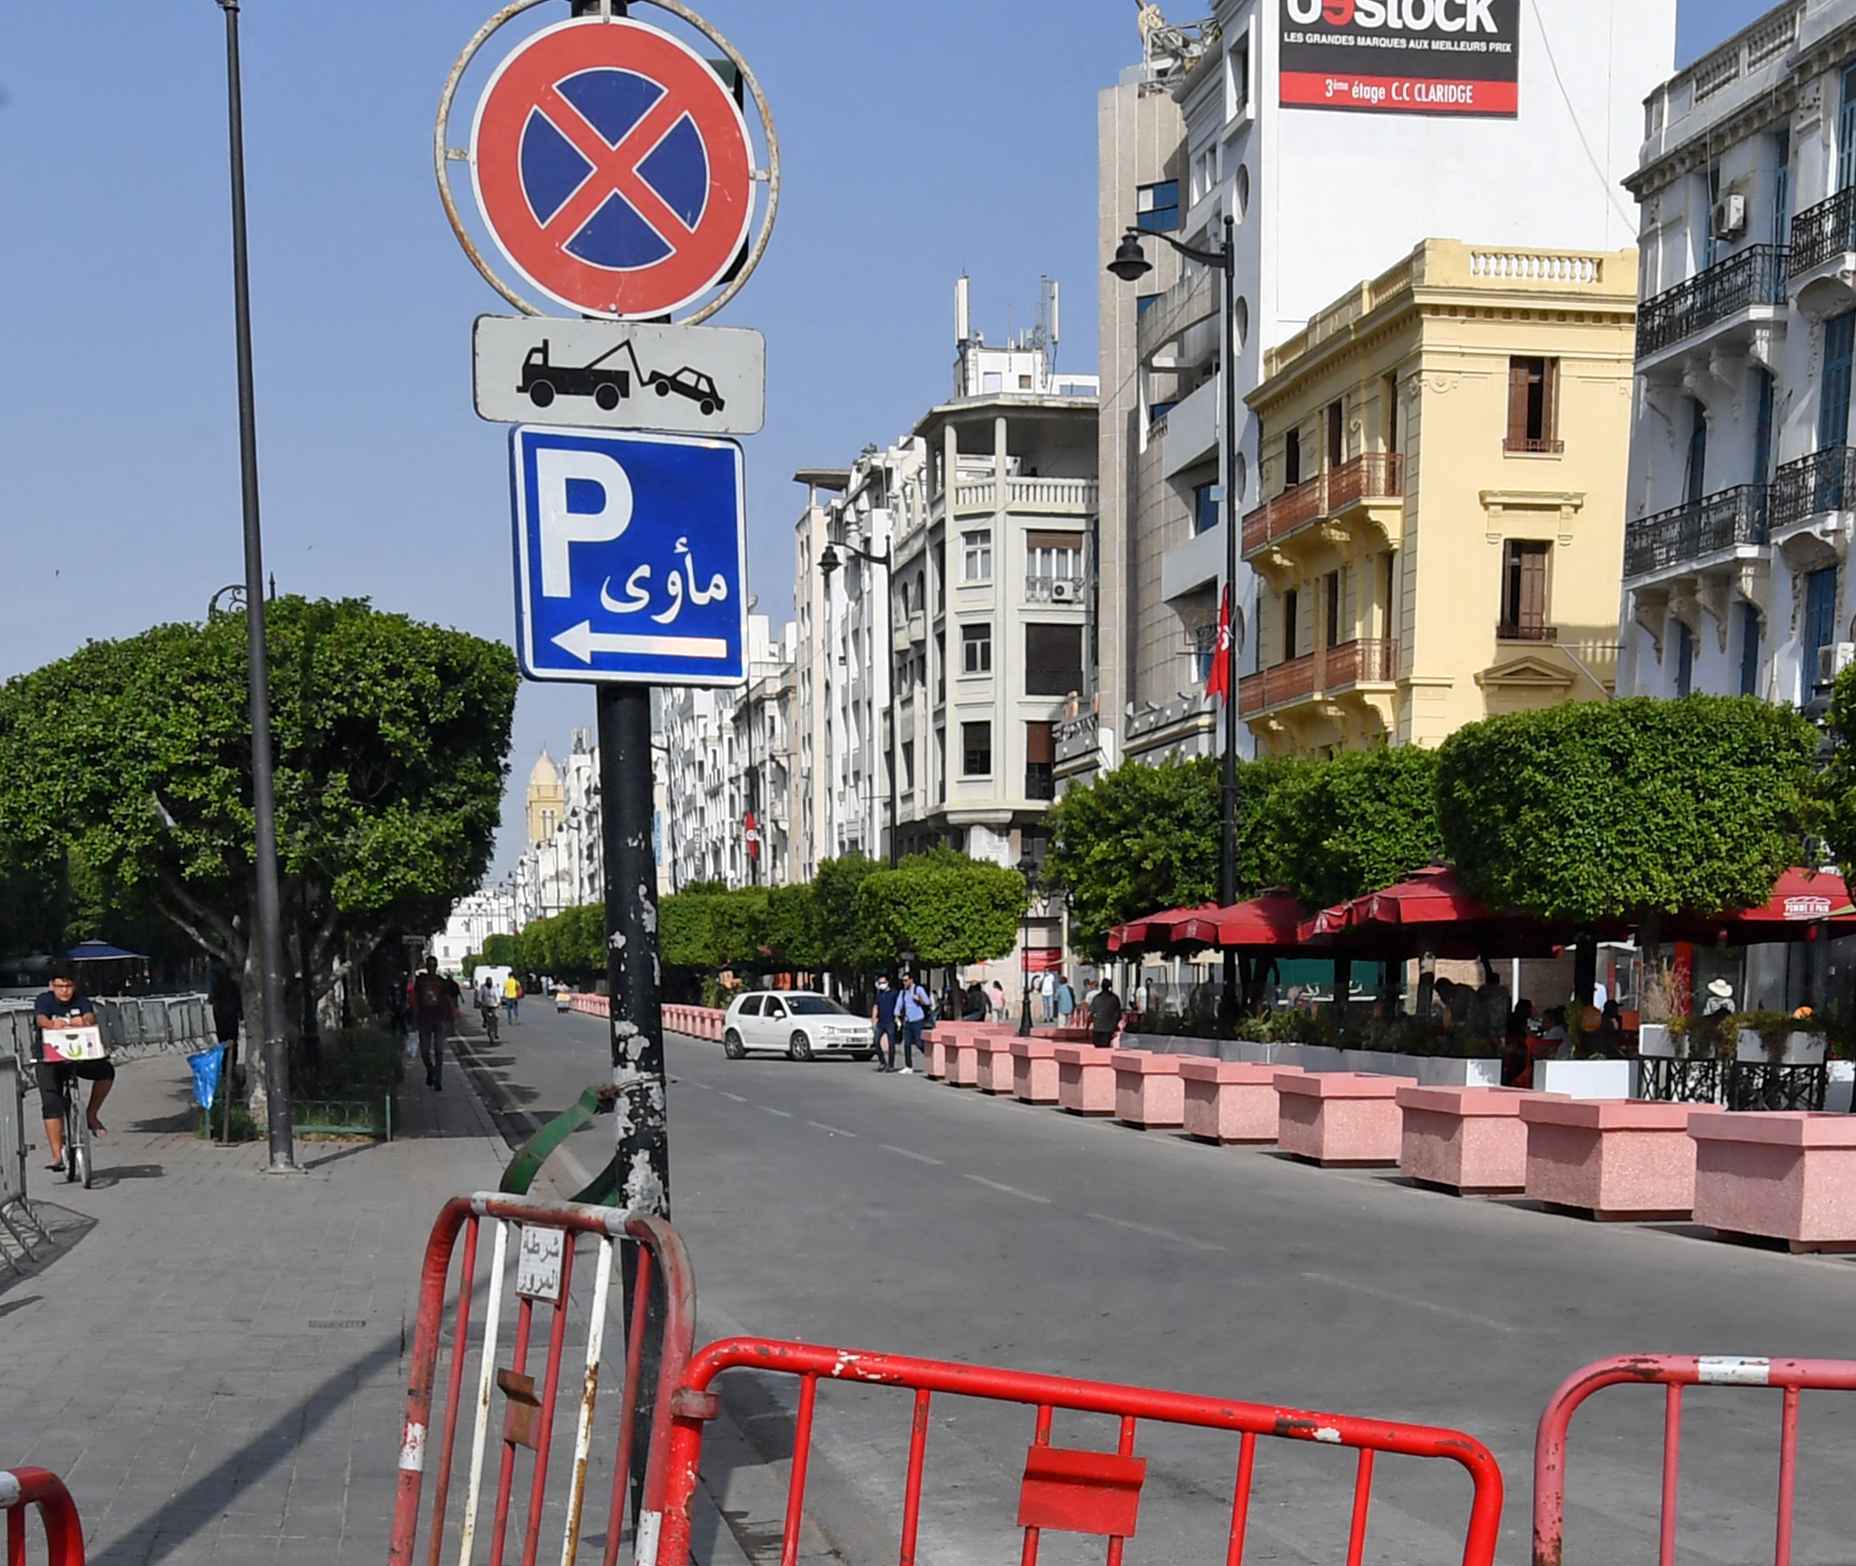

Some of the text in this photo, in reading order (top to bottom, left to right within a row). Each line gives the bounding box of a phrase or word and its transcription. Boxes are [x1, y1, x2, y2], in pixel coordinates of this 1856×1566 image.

[1284, 32, 1512, 53] LES GRANDES MARQUES AUX MEILLEURS PRIX
[1352, 81, 1386, 104] étage
[1391, 82, 1410, 102] C.C
[1414, 84, 1473, 103] CLARIDGE
[536, 448, 634, 598] P
[600, 536, 728, 624] مأوى
[519, 1269, 559, 1294] المرور
